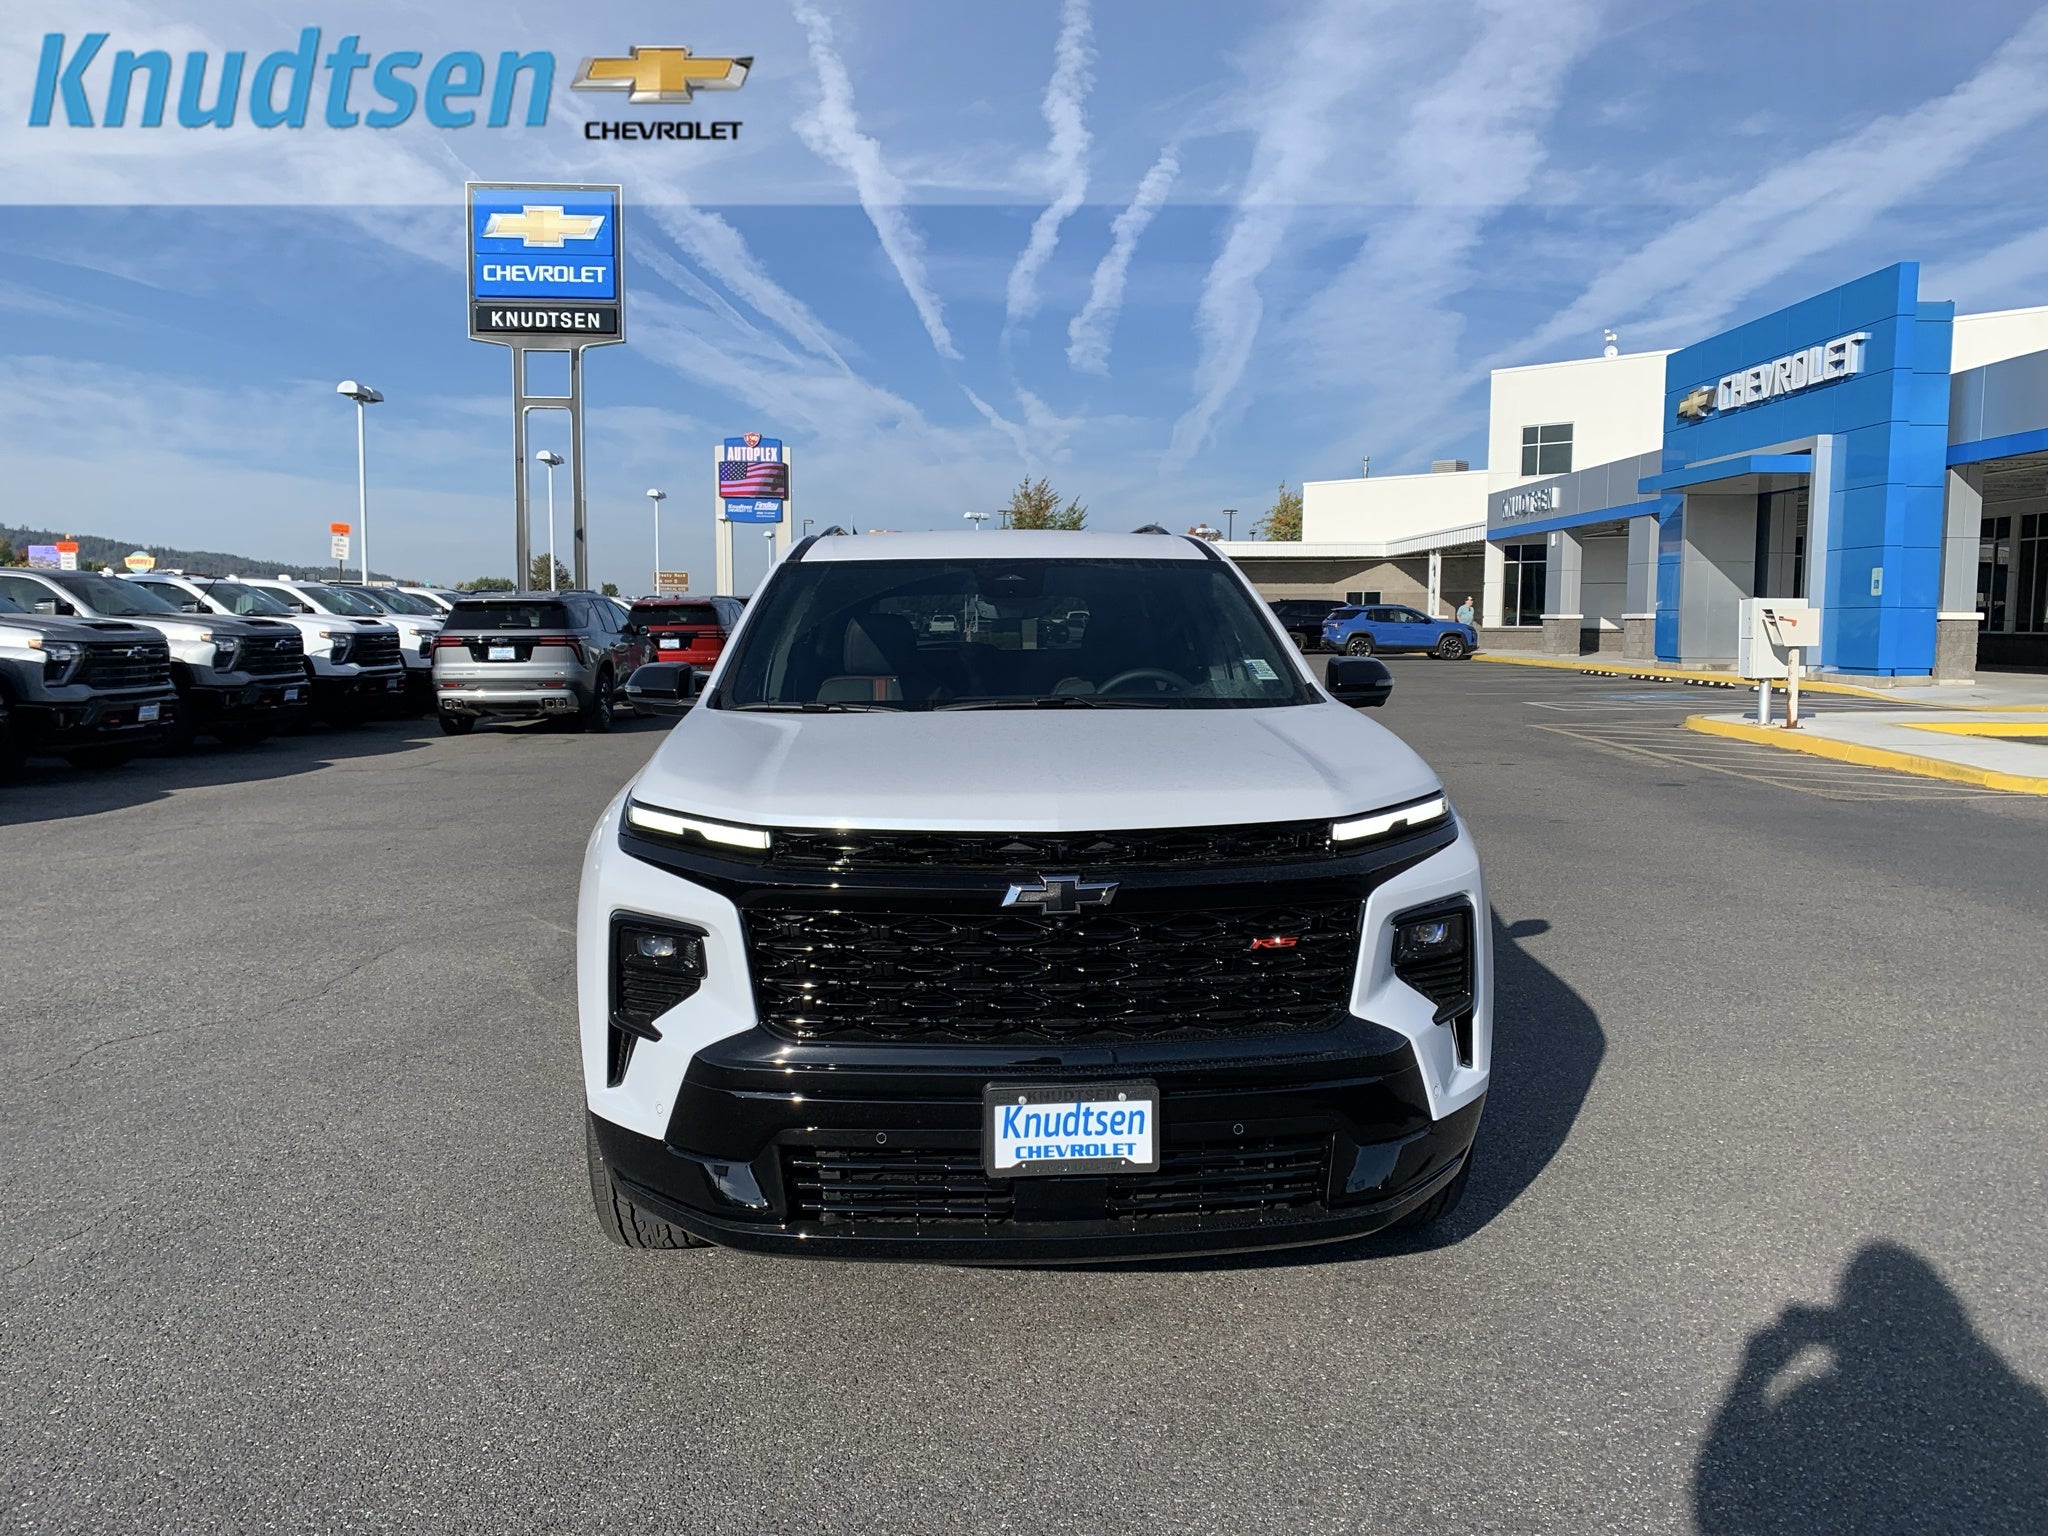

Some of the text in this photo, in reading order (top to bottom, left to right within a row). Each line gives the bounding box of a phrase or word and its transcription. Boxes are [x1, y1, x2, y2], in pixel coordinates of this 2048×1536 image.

[483, 264, 607, 283] CHEVROLET
[491, 311, 600, 329] KNUDTSEN
[1718, 331, 1872, 411] CHEVROLET
[727, 447, 778, 461] AUTOPLEX
[1502, 487, 1562, 518] KNUDTSEN
[1003, 1101, 1146, 1139] Knudtsen
[1015, 1142, 1137, 1159] CHEVROLET
